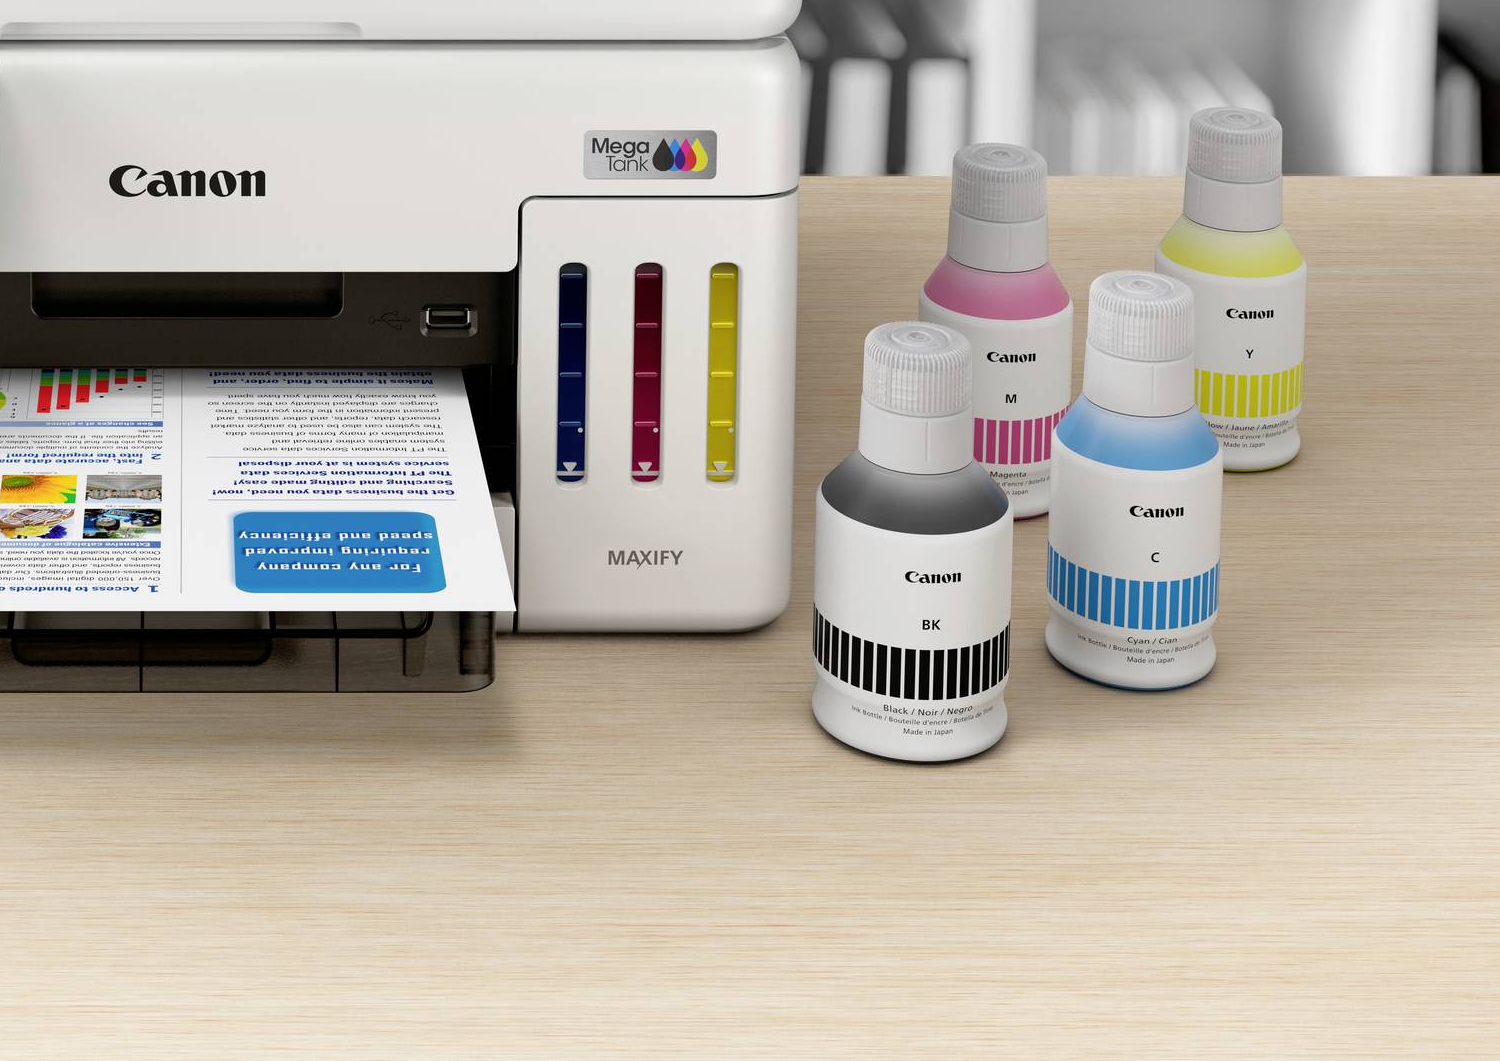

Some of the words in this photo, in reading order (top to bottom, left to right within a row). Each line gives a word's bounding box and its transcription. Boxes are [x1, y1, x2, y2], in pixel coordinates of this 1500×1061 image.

[591, 137, 650, 158] Mega
[605, 155, 648, 172] Tank
[108, 164, 266, 197] Canon
[1226, 308, 1274, 320] Canon
[986, 351, 1036, 363] Canon
[1246, 349, 1254, 359] Y
[1005, 394, 1017, 404] M
[1129, 505, 1184, 518] Canon
[238, 531, 331, 541] efficiency
[339, 533, 371, 541] and
[378, 531, 433, 541] speed
[245, 546, 333, 556] improved
[341, 546, 430, 556] requiring
[607, 550, 684, 569] MAXIFY
[1151, 552, 1160, 563] C
[257, 562, 341, 572] company
[349, 562, 381, 572] any
[389, 563, 421, 572] For
[904, 570, 962, 584] Canon
[922, 620, 940, 631] BK
[1088, 638, 1107, 648] Bottle
[1113, 645, 1143, 654] Bouteille
[884, 704, 908, 715] Black
[947, 706, 973, 716] Negro
[863, 709, 882, 719] Bottle
[889, 716, 920, 725] Bouteille
